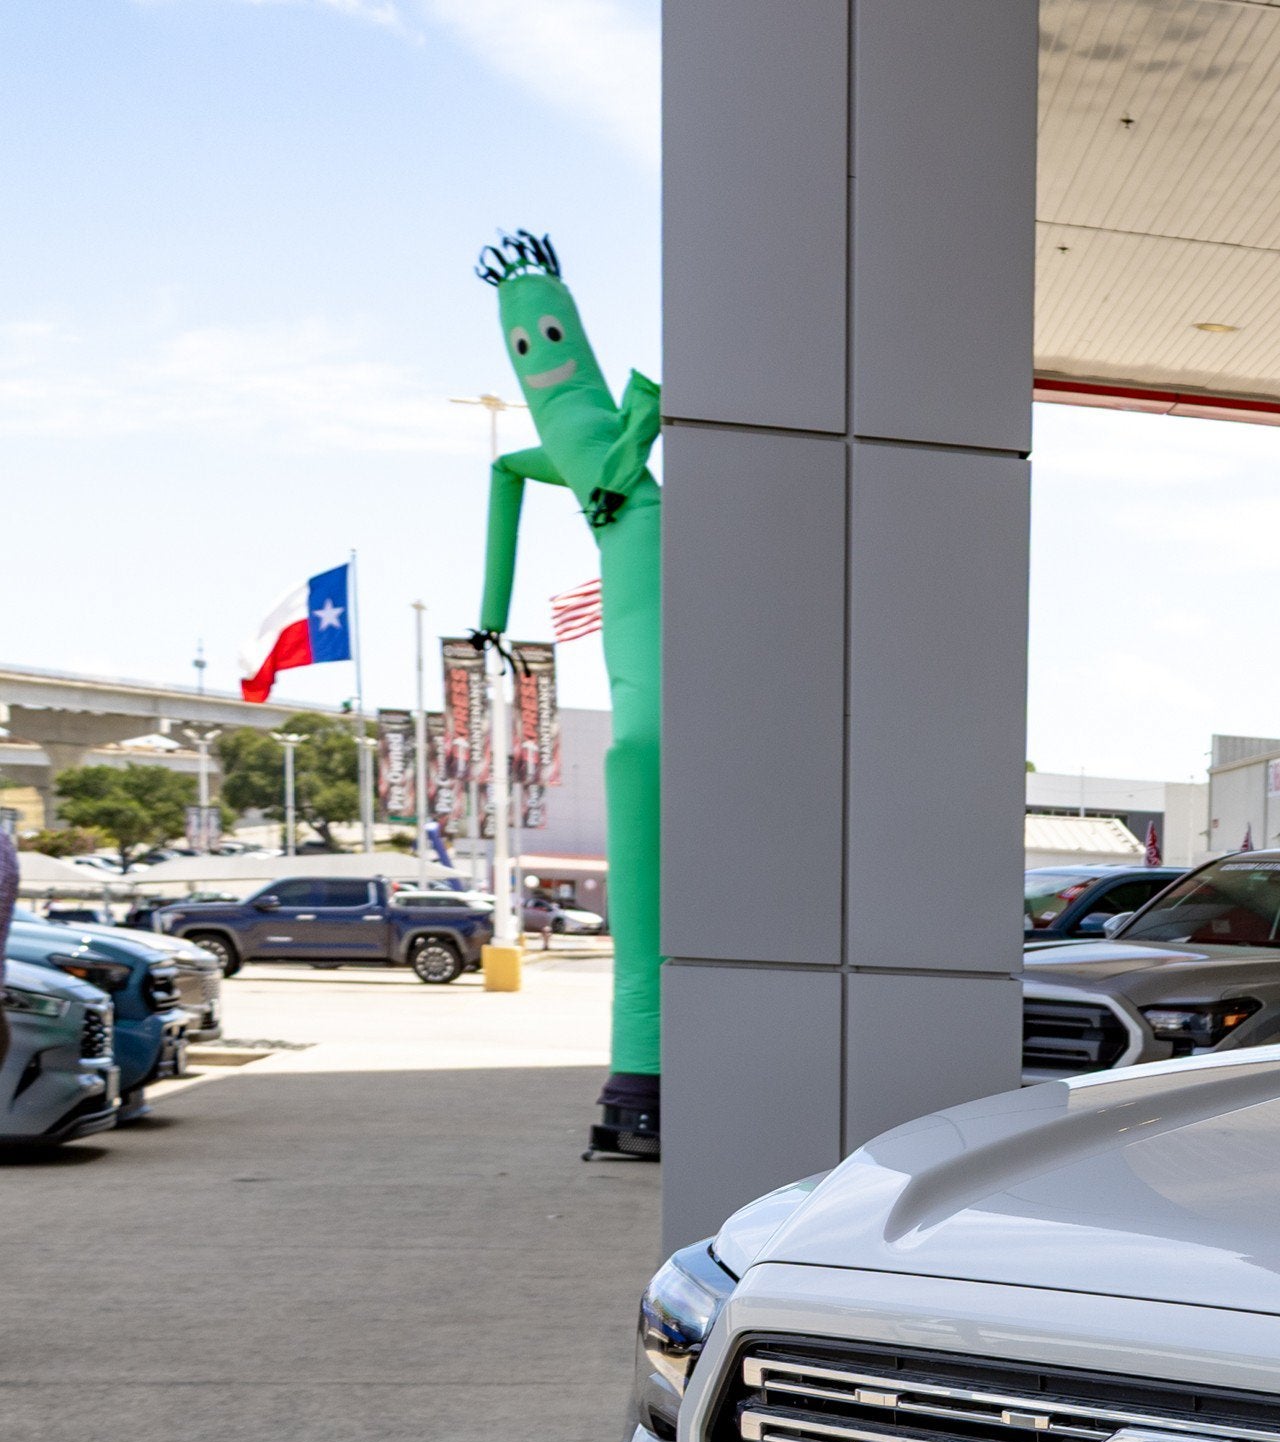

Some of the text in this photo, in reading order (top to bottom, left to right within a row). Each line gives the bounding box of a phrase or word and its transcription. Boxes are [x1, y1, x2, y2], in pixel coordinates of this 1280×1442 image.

[469, 672, 482, 762] MAINTENANCE
[538, 675, 552, 765] MAINTENANCE
[385, 733, 404, 810] Pre Owned
